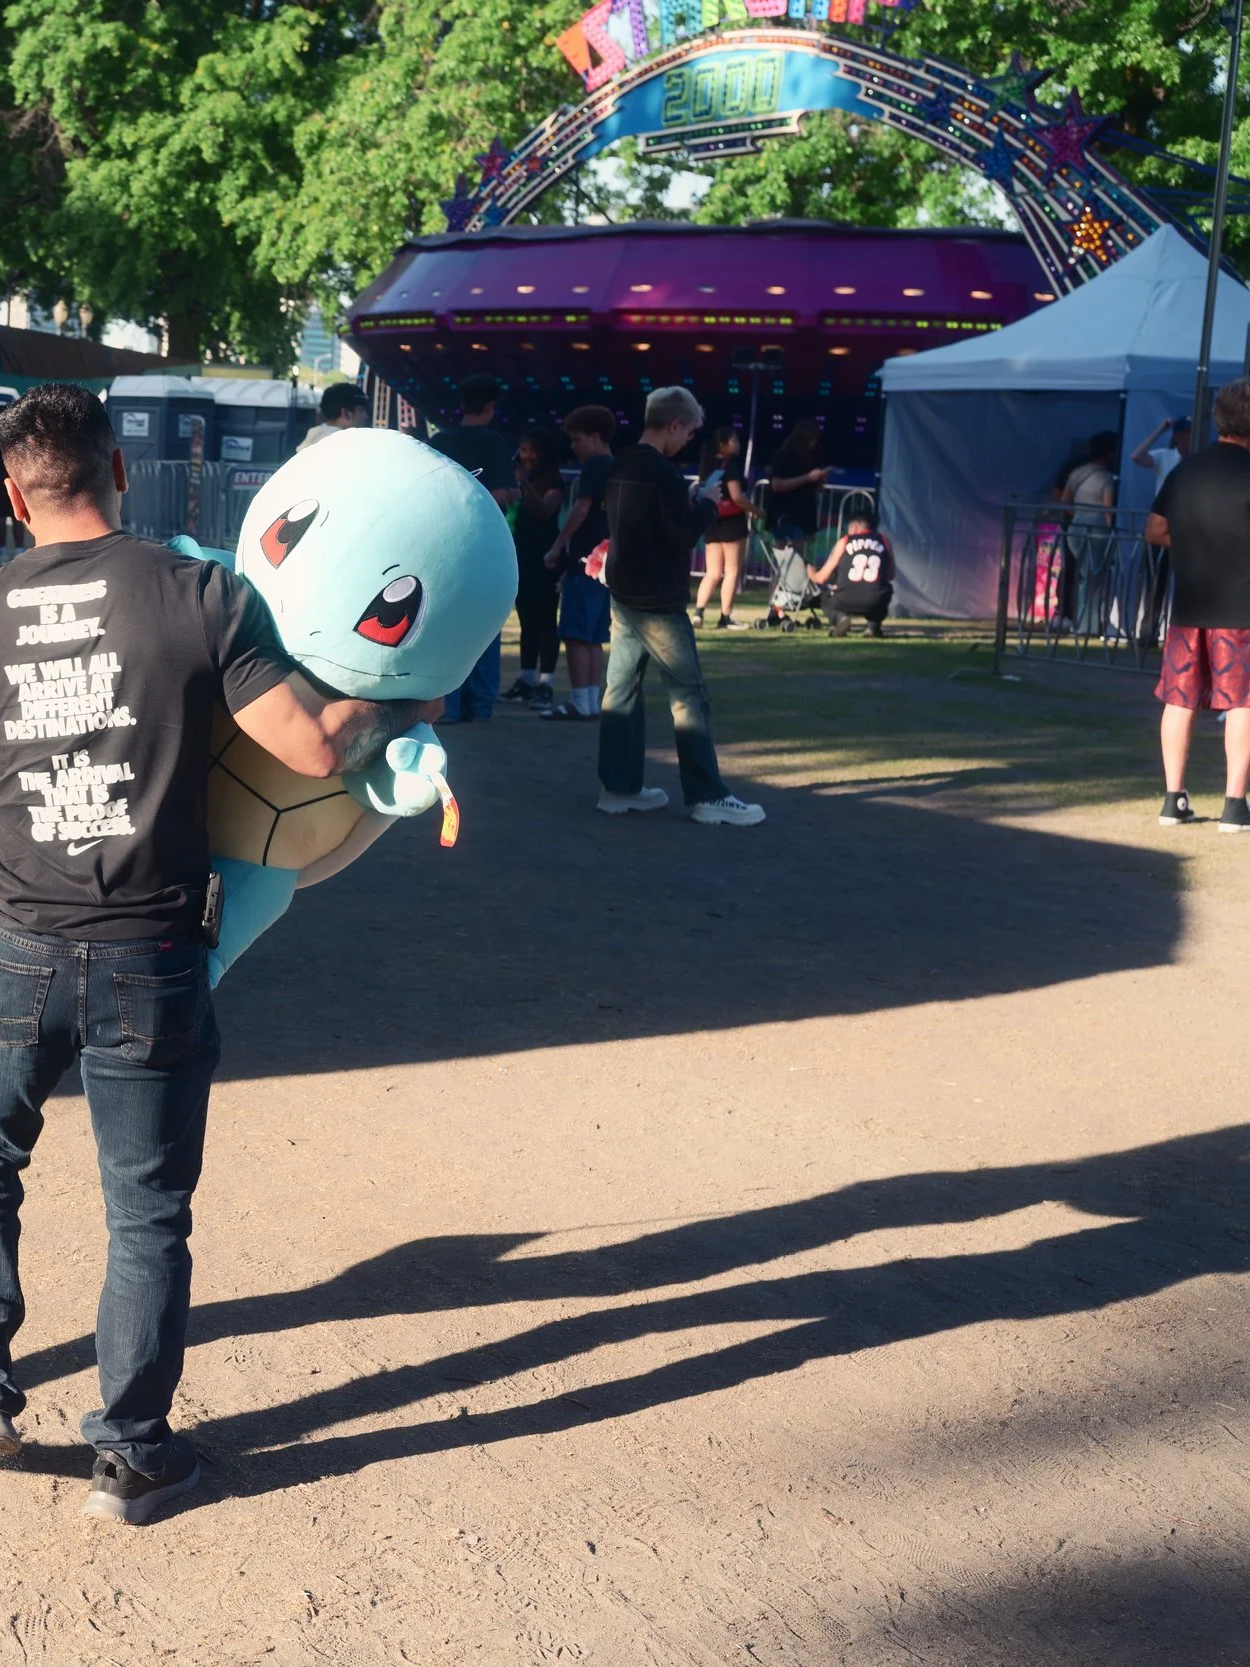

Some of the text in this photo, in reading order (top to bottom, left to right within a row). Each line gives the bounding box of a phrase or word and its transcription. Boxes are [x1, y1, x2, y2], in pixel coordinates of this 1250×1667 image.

[662, 50, 785, 127] 2000
[848, 553, 881, 583] 33
[40, 604, 76, 625] IS A
[16, 617, 106, 646] JOURNEY.
[4, 652, 122, 685] WE WILL ALL
[18, 672, 114, 702] ARRIVE AT
[21, 692, 114, 720] DIFFERENT
[4, 706, 137, 741] DESTINATIONS.
[52, 749, 91, 771] IT IS
[18, 762, 135, 791] THE ARRIVAL
[41, 784, 110, 807] THAT IS
[28, 798, 129, 823] THE PROOF
[31, 815, 136, 842] OF SUCCESS.
